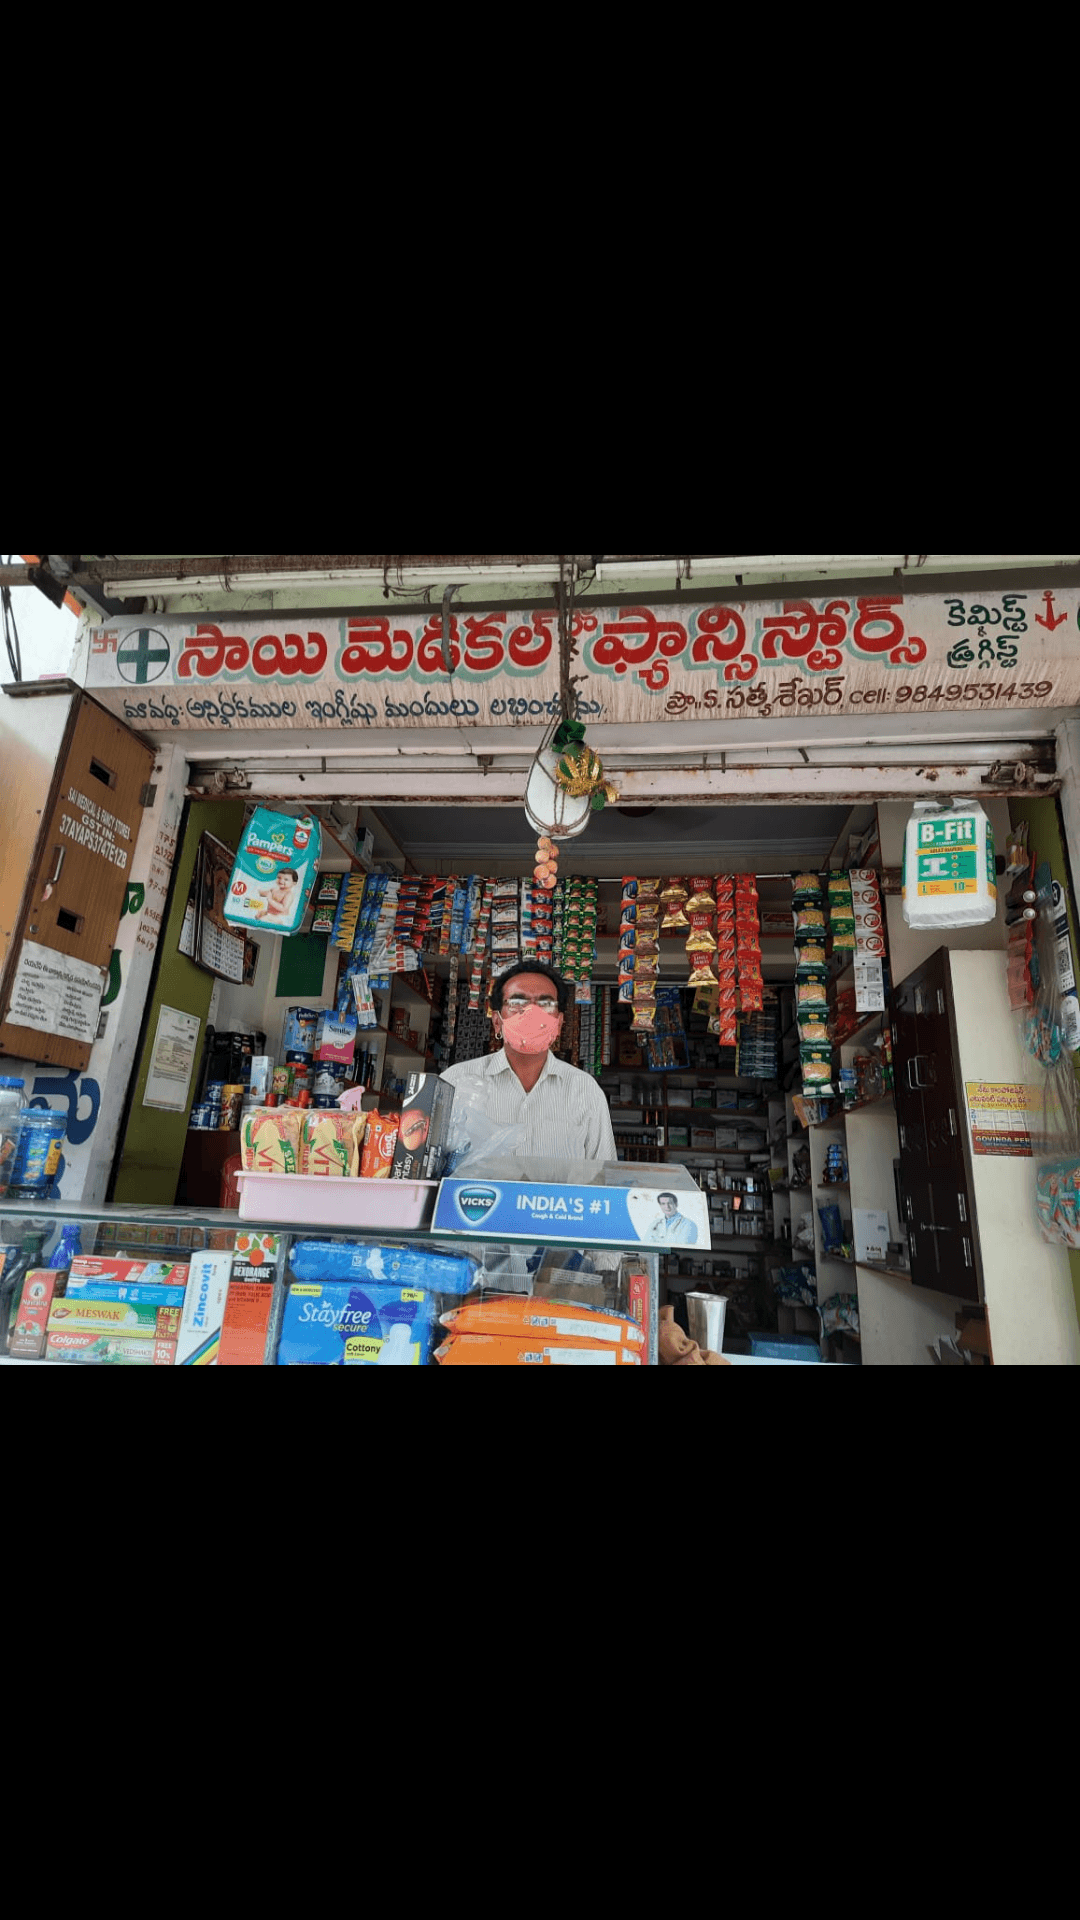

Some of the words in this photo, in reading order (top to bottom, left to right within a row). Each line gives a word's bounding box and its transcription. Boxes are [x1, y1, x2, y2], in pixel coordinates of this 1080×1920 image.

[944, 594, 1028, 633] కెమిస్ట్
[178, 623, 328, 677] సాయి
[341, 604, 557, 675] మెడికల్
[761, 597, 927, 672] స్టోర్స్
[850, 687, 891, 705] cell:
[895, 681, 1053, 705] 9849531439
[385, 691, 479, 718] మందులు
[67, 786, 78, 805] SAI
[76, 792, 97, 818] MEDICAL
[101, 808, 116, 830] FANCY
[81, 813, 102, 833] GST
[921, 821, 973, 842] B-Fit
[247, 832, 294, 857] Pampers
[233, 883, 244, 893] M
[461, 1196, 494, 1208] VICKS
[516, 1194, 585, 1214] INDIA'S
[589, 1198, 611, 1215] #1
[233, 1266, 270, 1278] DEXORANGE
[193, 1263, 212, 1328] Zincovit
[74, 1308, 121, 1321] MESWAK
[160, 1307, 180, 1316] FREE
[298, 1301, 373, 1328] Stayfree
[332, 1323, 369, 1333] secure
[49, 1334, 91, 1346] Colgate
[346, 1343, 381, 1355] Cottony
[156, 1349, 171, 1359] 10%
